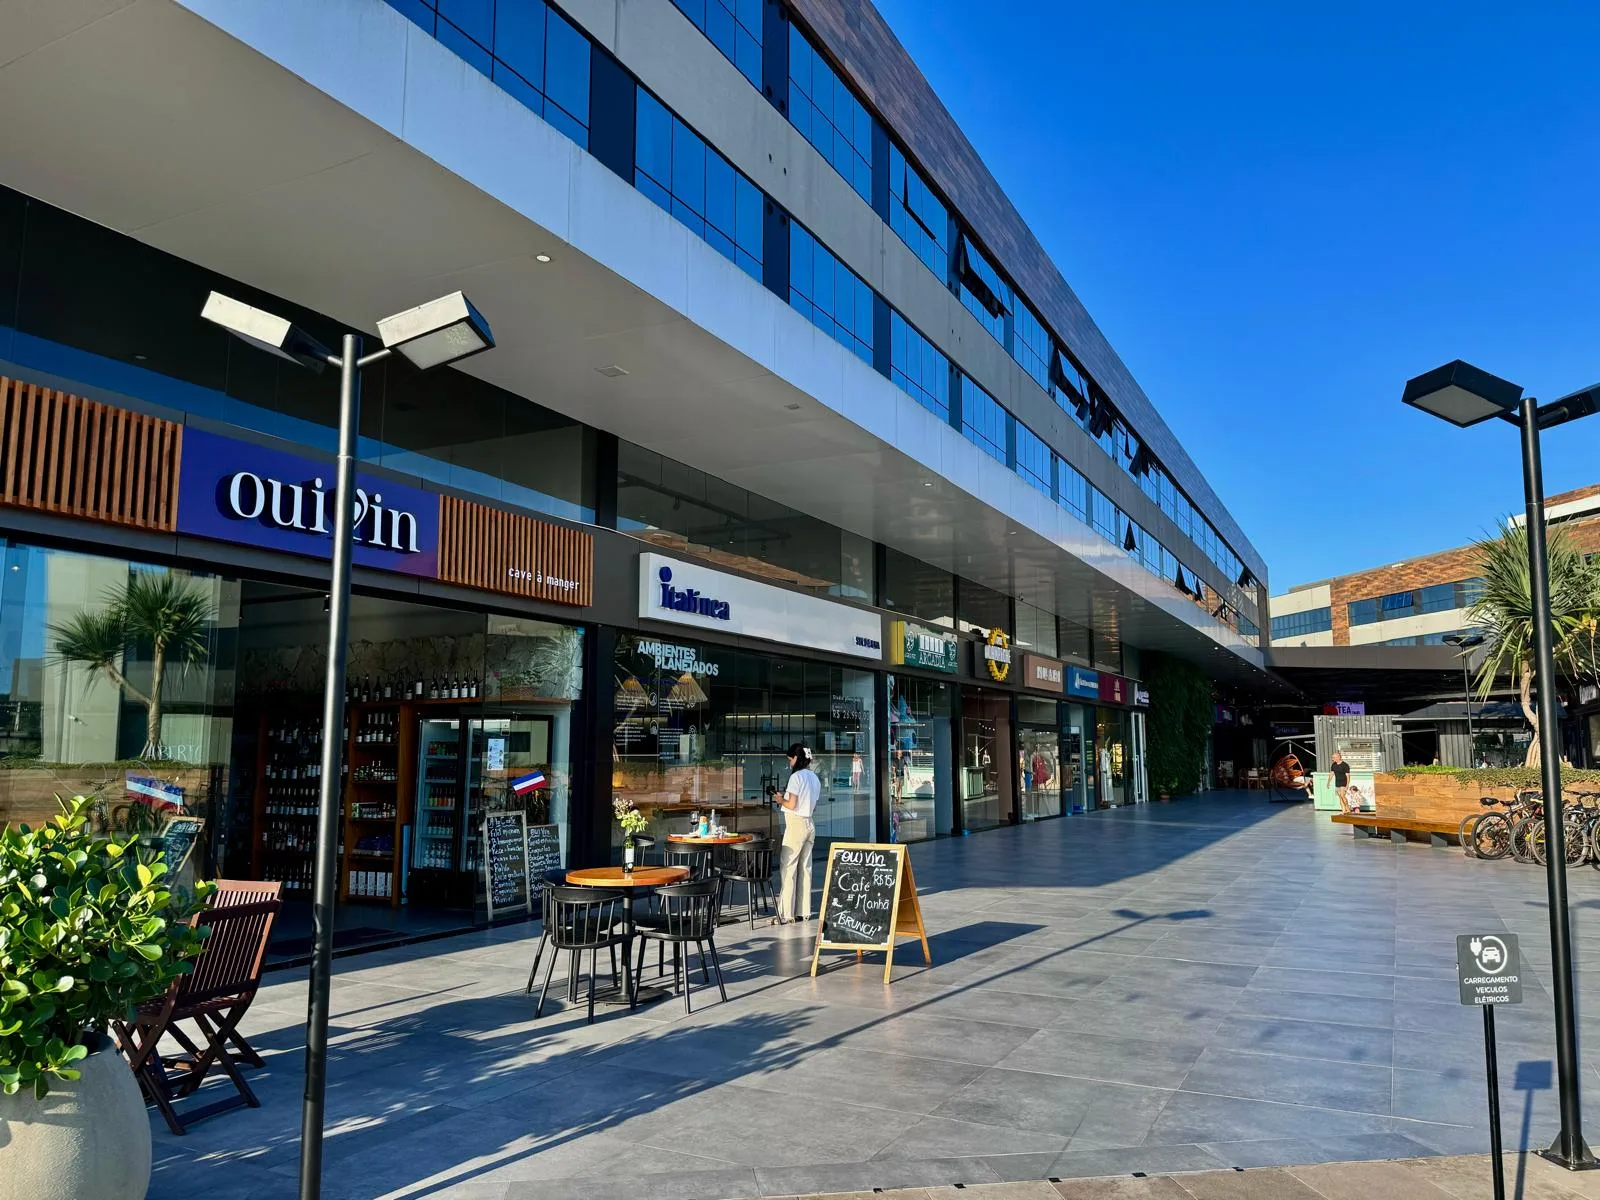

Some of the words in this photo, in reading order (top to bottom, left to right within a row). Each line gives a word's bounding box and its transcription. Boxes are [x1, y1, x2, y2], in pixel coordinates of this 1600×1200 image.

[508, 567, 532, 581] cave
[536, 570, 543, 583] à
[546, 575, 580, 591] manger
[637, 641, 696, 660] AMBIENTES
[919, 651, 946, 668] ARCADIA
[655, 656, 719, 676] PLANEJADOS
[1337, 705, 1352, 714] TEA
[855, 893, 889, 915] Manhã
[1464, 975, 1518, 984] CARREGAMENTO
[1474, 995, 1509, 1004] ELÉTRICOS
